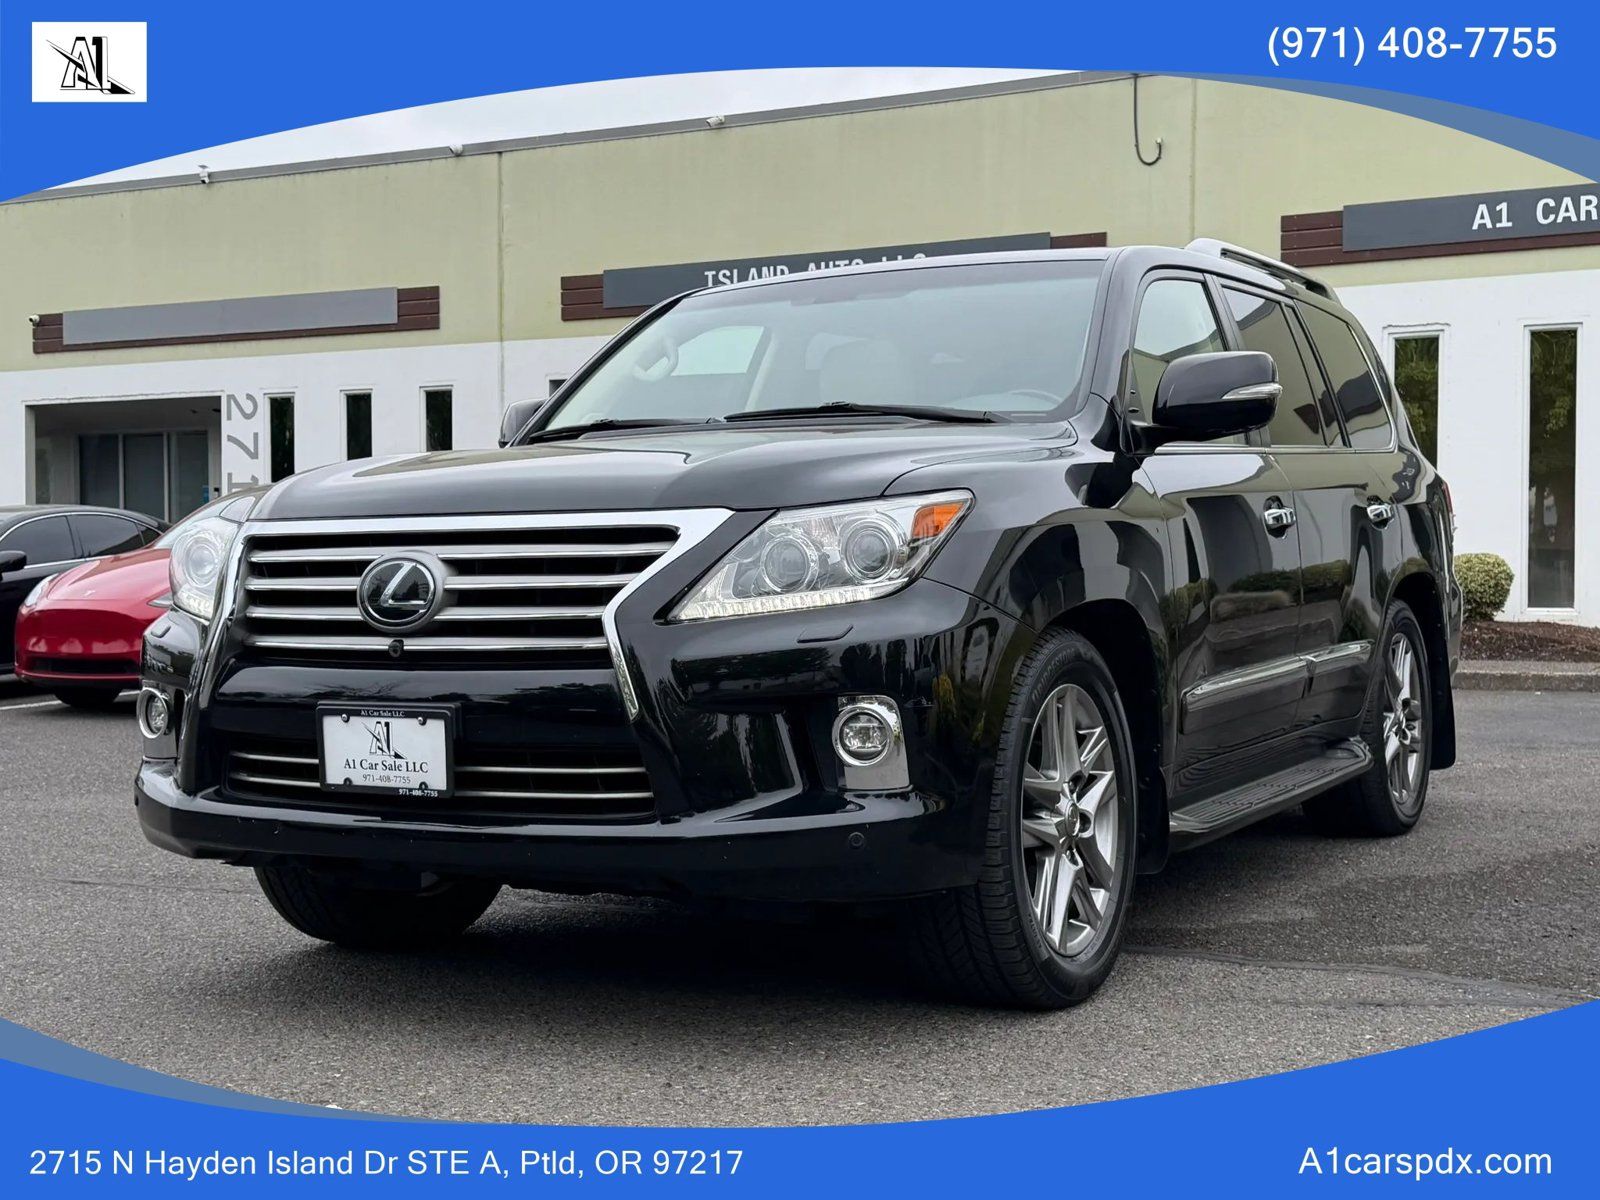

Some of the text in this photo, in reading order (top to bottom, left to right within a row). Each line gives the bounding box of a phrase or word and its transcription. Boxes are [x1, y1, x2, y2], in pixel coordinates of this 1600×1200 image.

[1471, 202, 1513, 230] A1
[343, 758, 429, 773] A1 Car Sale LLC
[362, 774, 411, 784] 971-408-7755
